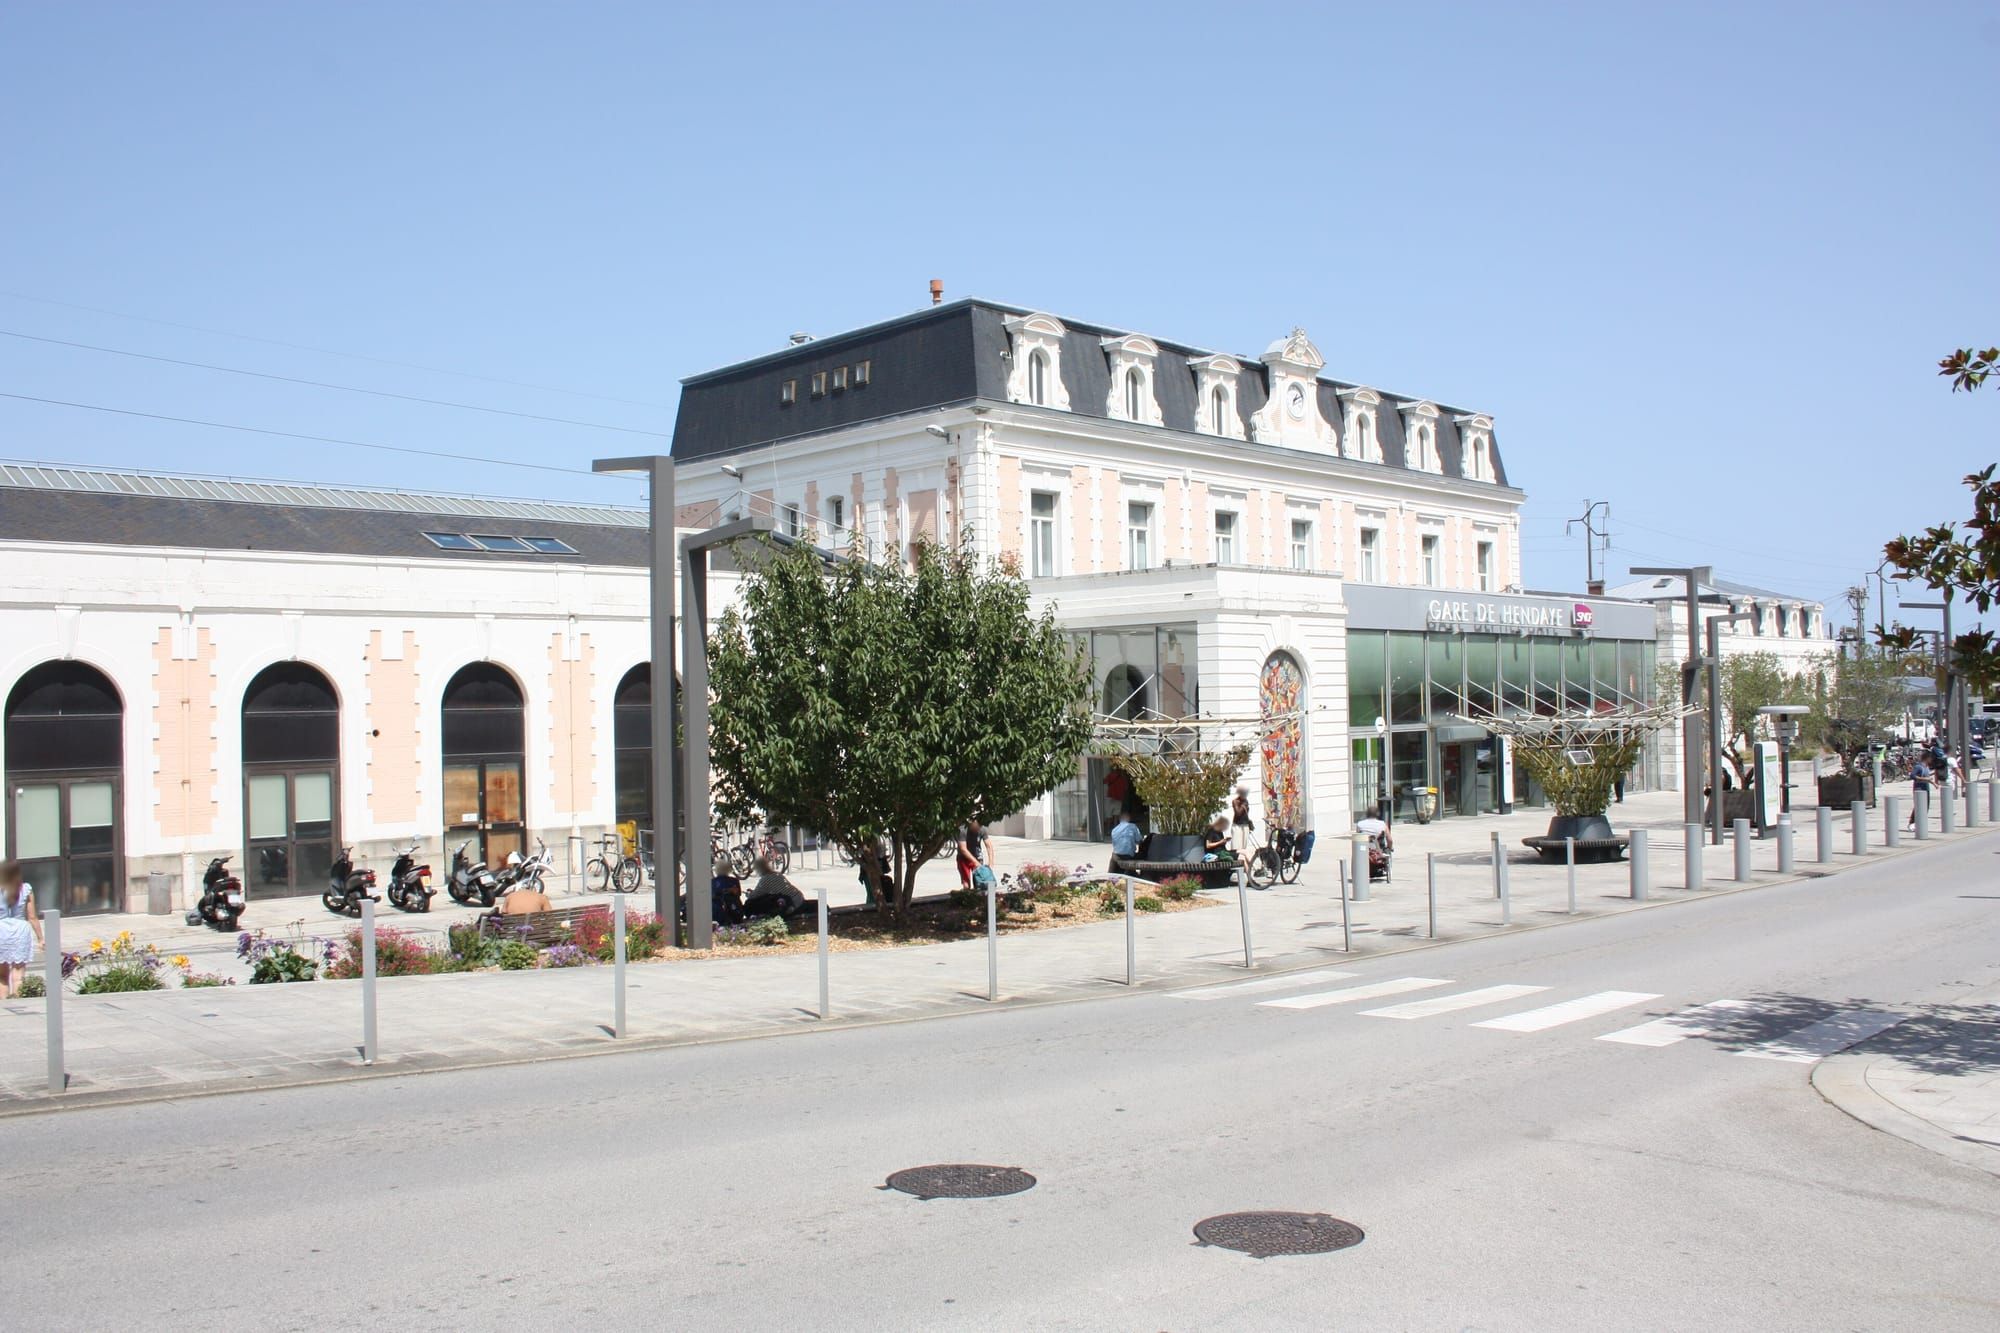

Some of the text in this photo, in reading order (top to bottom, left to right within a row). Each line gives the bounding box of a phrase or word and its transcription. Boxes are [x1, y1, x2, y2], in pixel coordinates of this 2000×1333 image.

[1429, 600, 1563, 626] GARE DE HENDAYE
[1576, 611, 1593, 623] SNCF
